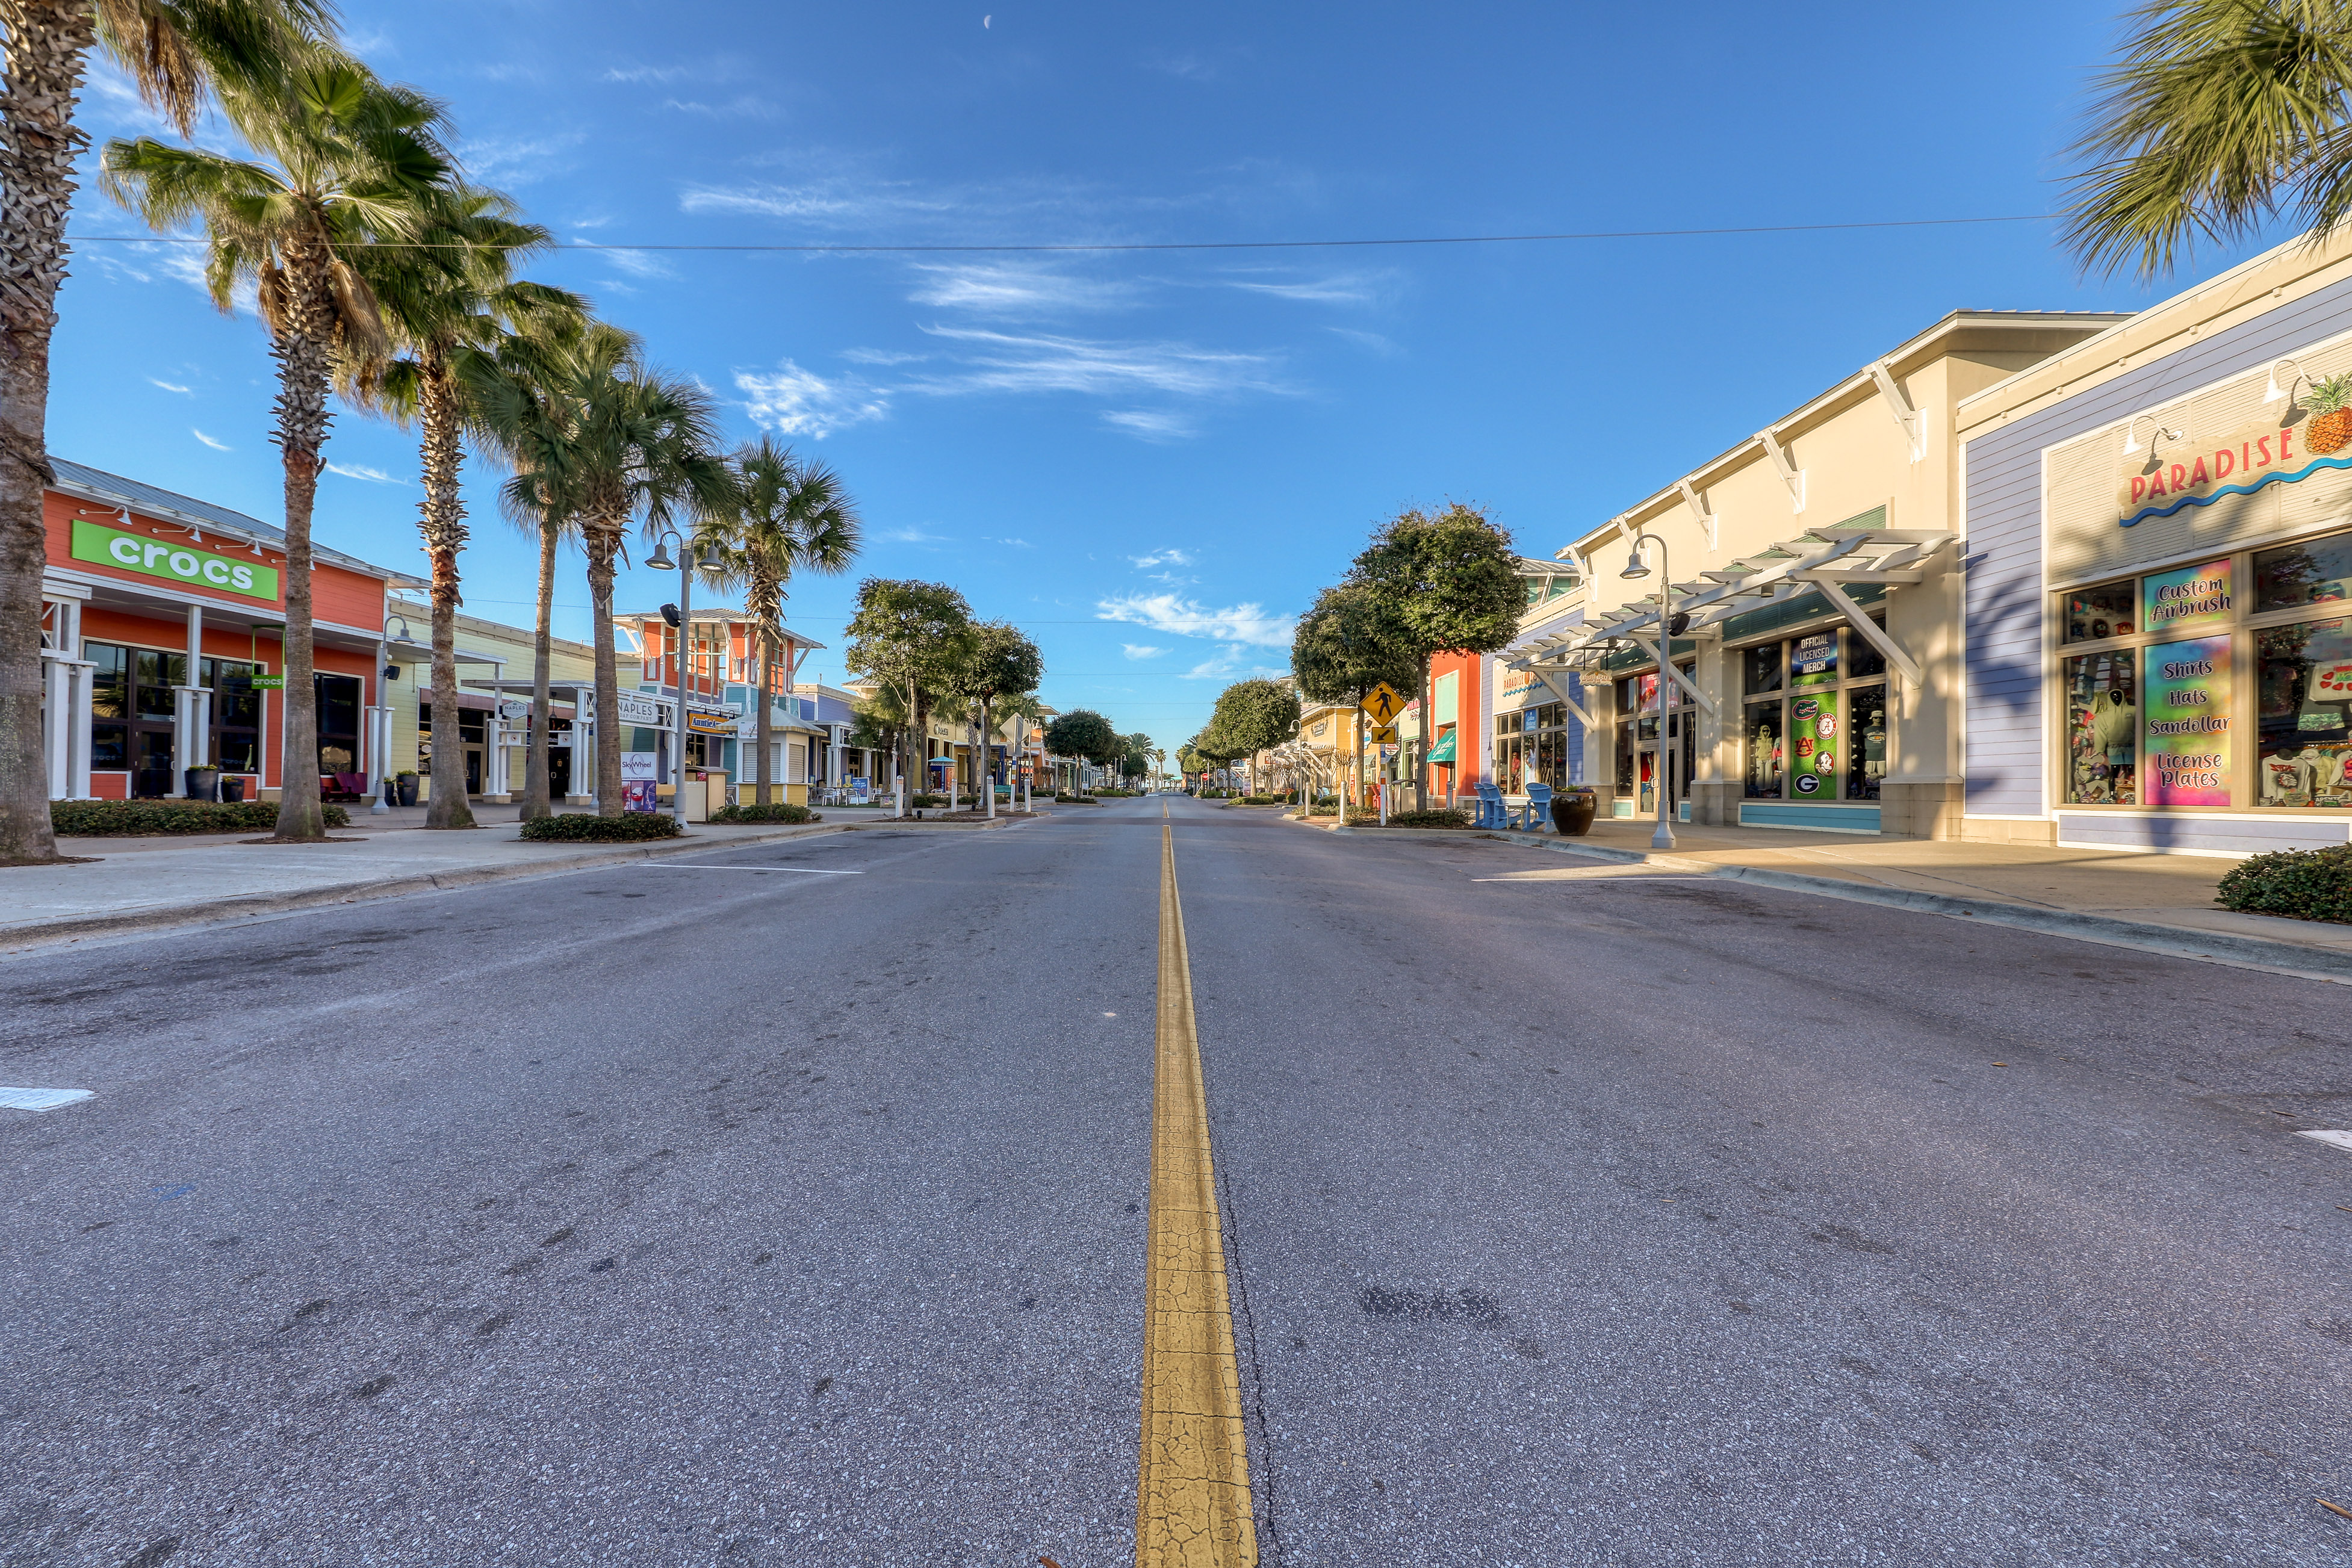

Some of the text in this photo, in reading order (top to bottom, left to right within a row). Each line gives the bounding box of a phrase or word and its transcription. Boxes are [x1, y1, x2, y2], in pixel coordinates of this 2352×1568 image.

[2131, 428, 2292, 504] PARADISE
[110, 538, 253, 589] crocs
[2159, 578, 2224, 601] Custom
[2152, 592, 2230, 622] Airbrush
[1801, 634, 1828, 649] OFFICIAL
[1799, 647, 1829, 662] LICENSED
[1803, 660, 1825, 673] MERCH
[2164, 660, 2212, 678] Shirts
[1504, 675, 1523, 690] PARADISE
[2170, 690, 2207, 705] Hats
[618, 702, 652, 716] NAPLES
[2150, 716, 2231, 735] Sandollar
[2158, 753, 2222, 770] License
[2161, 770, 2219, 788] Plates
